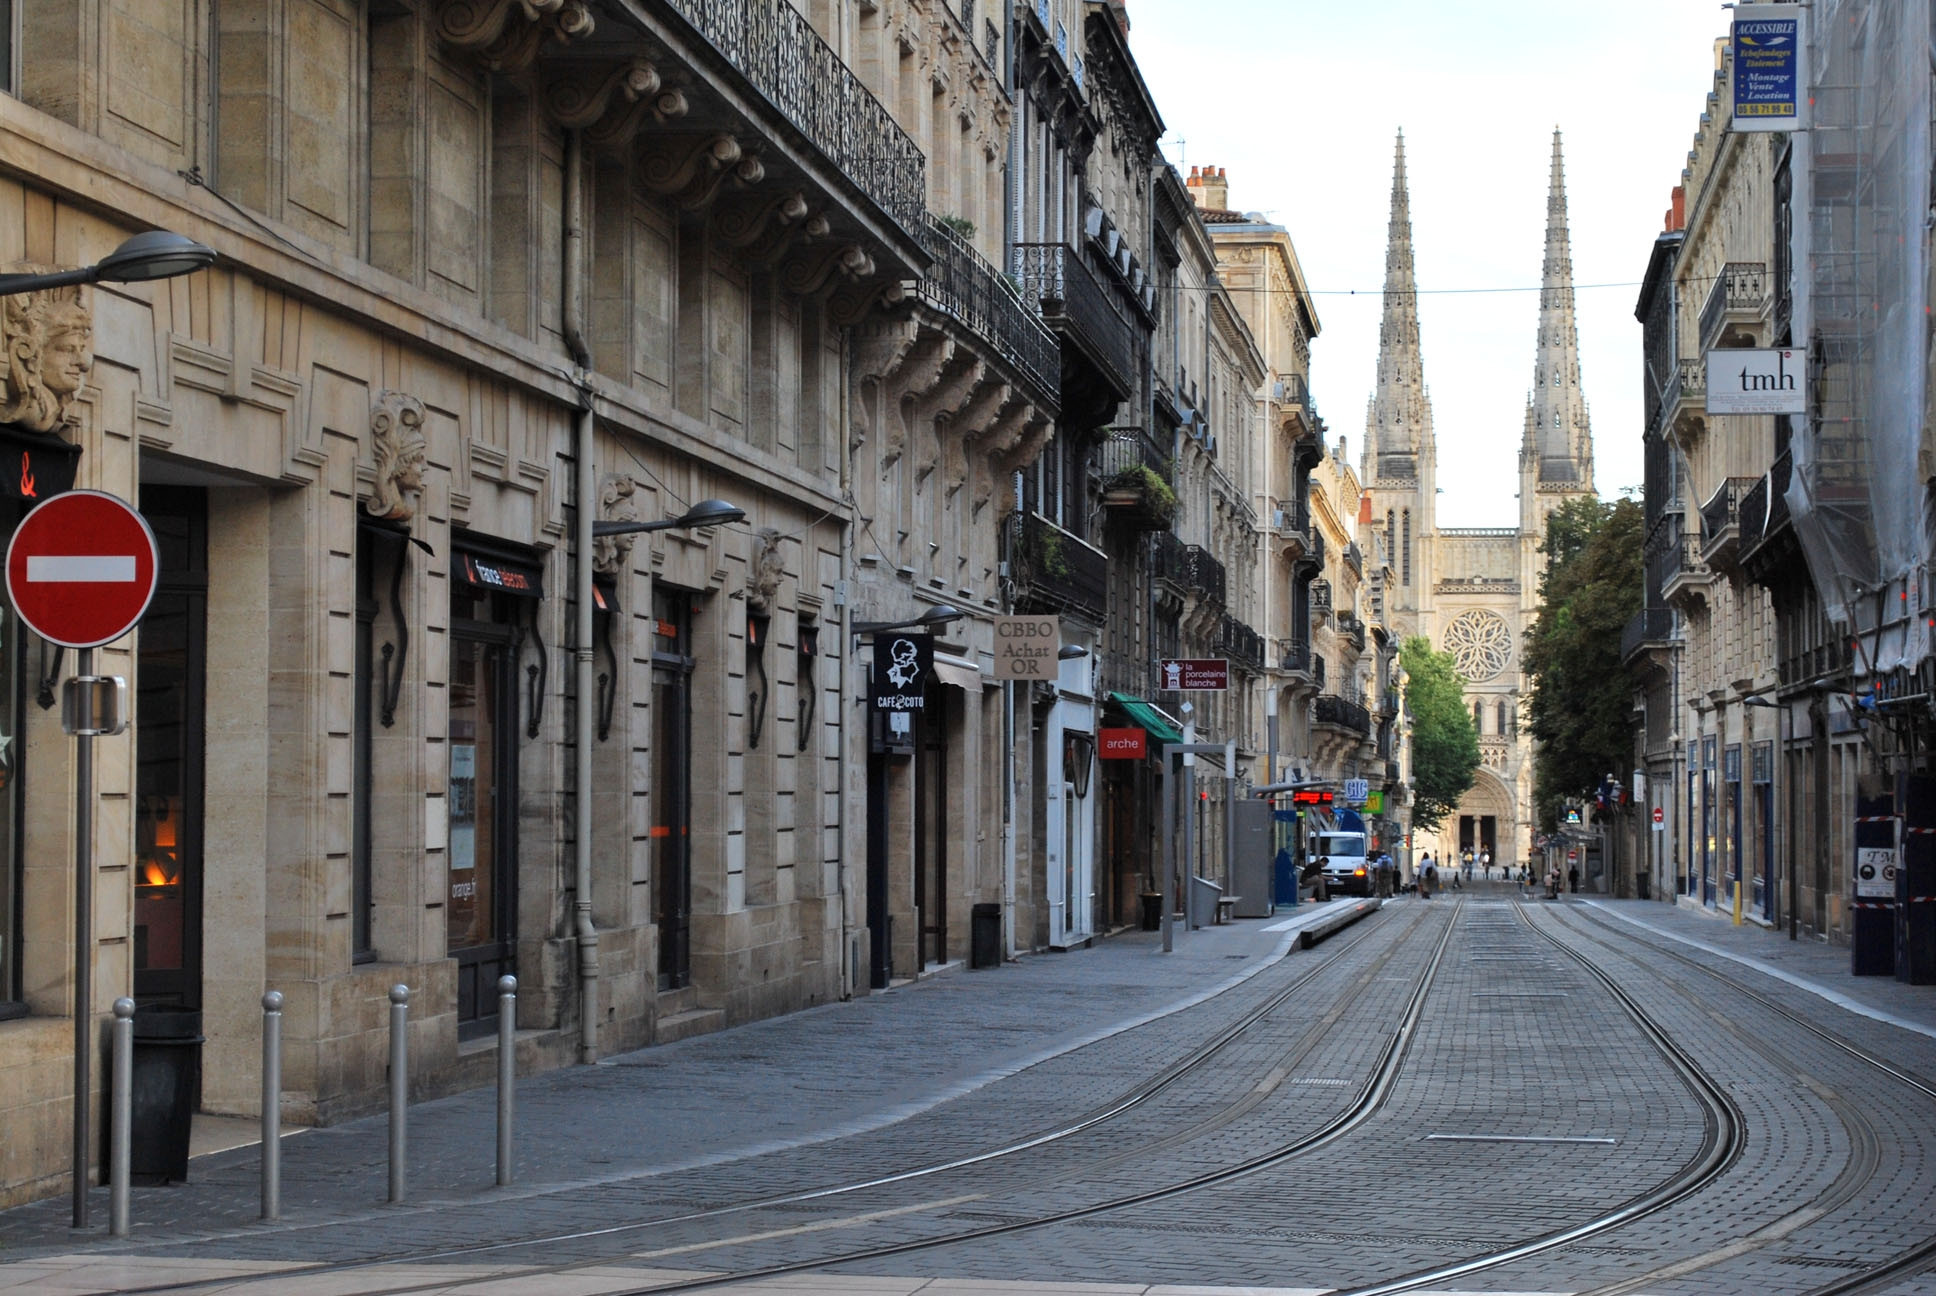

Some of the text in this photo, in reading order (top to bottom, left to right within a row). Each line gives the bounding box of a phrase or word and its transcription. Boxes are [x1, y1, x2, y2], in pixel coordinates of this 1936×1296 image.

[1736, 23, 1795, 34] ACCESSIBLE
[1748, 73, 1790, 83] Montage
[1749, 82, 1774, 90] Vente
[1747, 91, 1790, 99] Location
[1738, 351, 1796, 391] tmh
[999, 622, 1053, 637] CBBO
[1002, 643, 1050, 658] Achat
[1011, 659, 1041, 674] OR
[1185, 663, 1193, 671] la
[1185, 671, 1227, 679] porcelaine
[904, 696, 924, 708] COTO
[1106, 739, 1139, 749] arche
